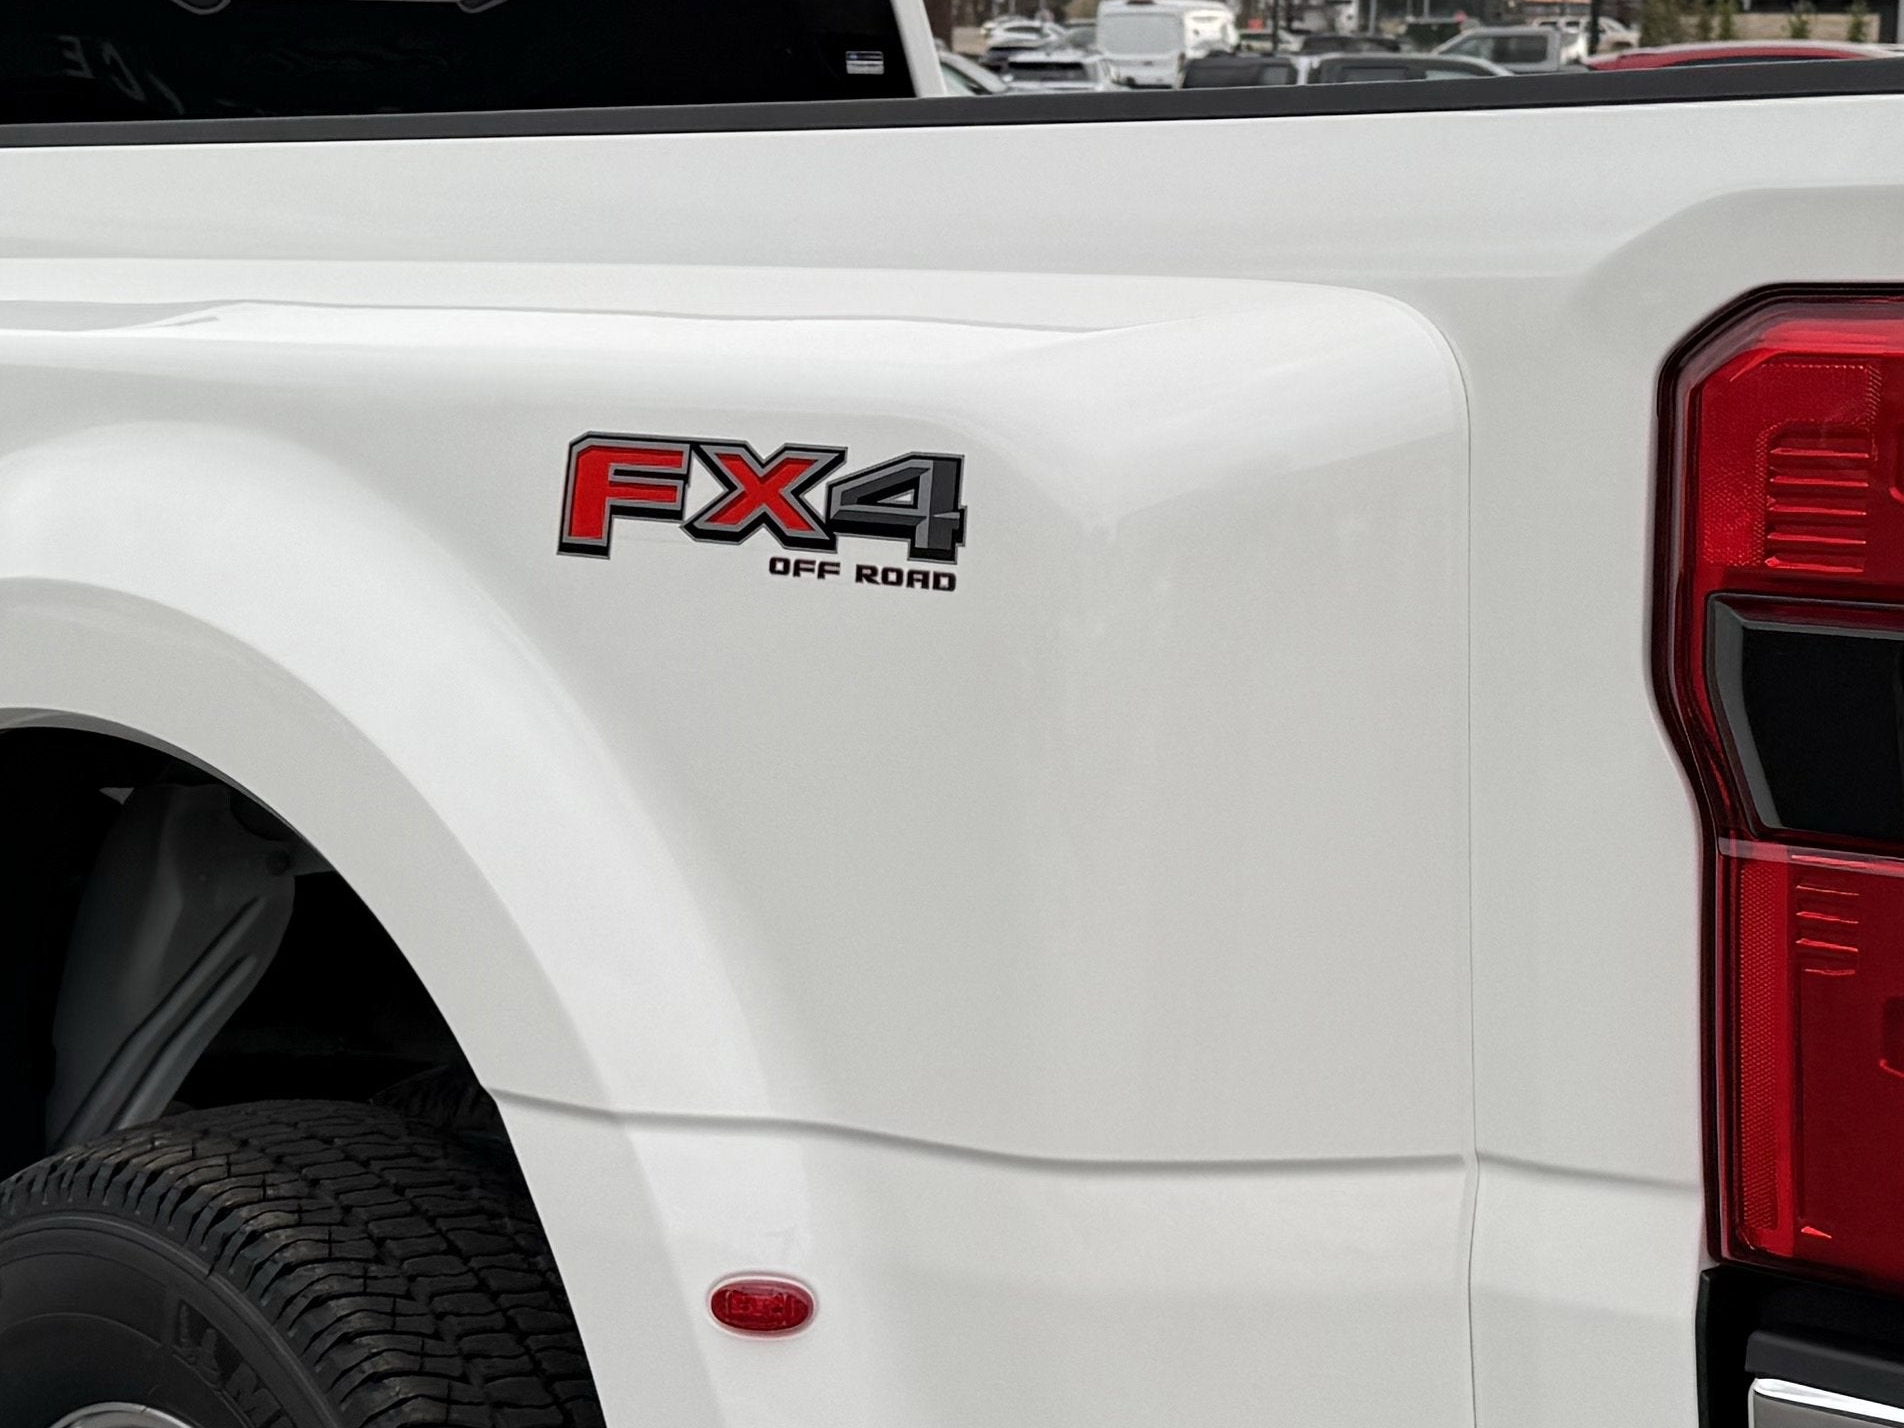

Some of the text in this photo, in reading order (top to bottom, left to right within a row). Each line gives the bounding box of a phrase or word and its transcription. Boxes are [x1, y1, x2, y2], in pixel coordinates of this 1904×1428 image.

[556, 431, 968, 564] FX4
[768, 556, 957, 593] OFF ROAD
